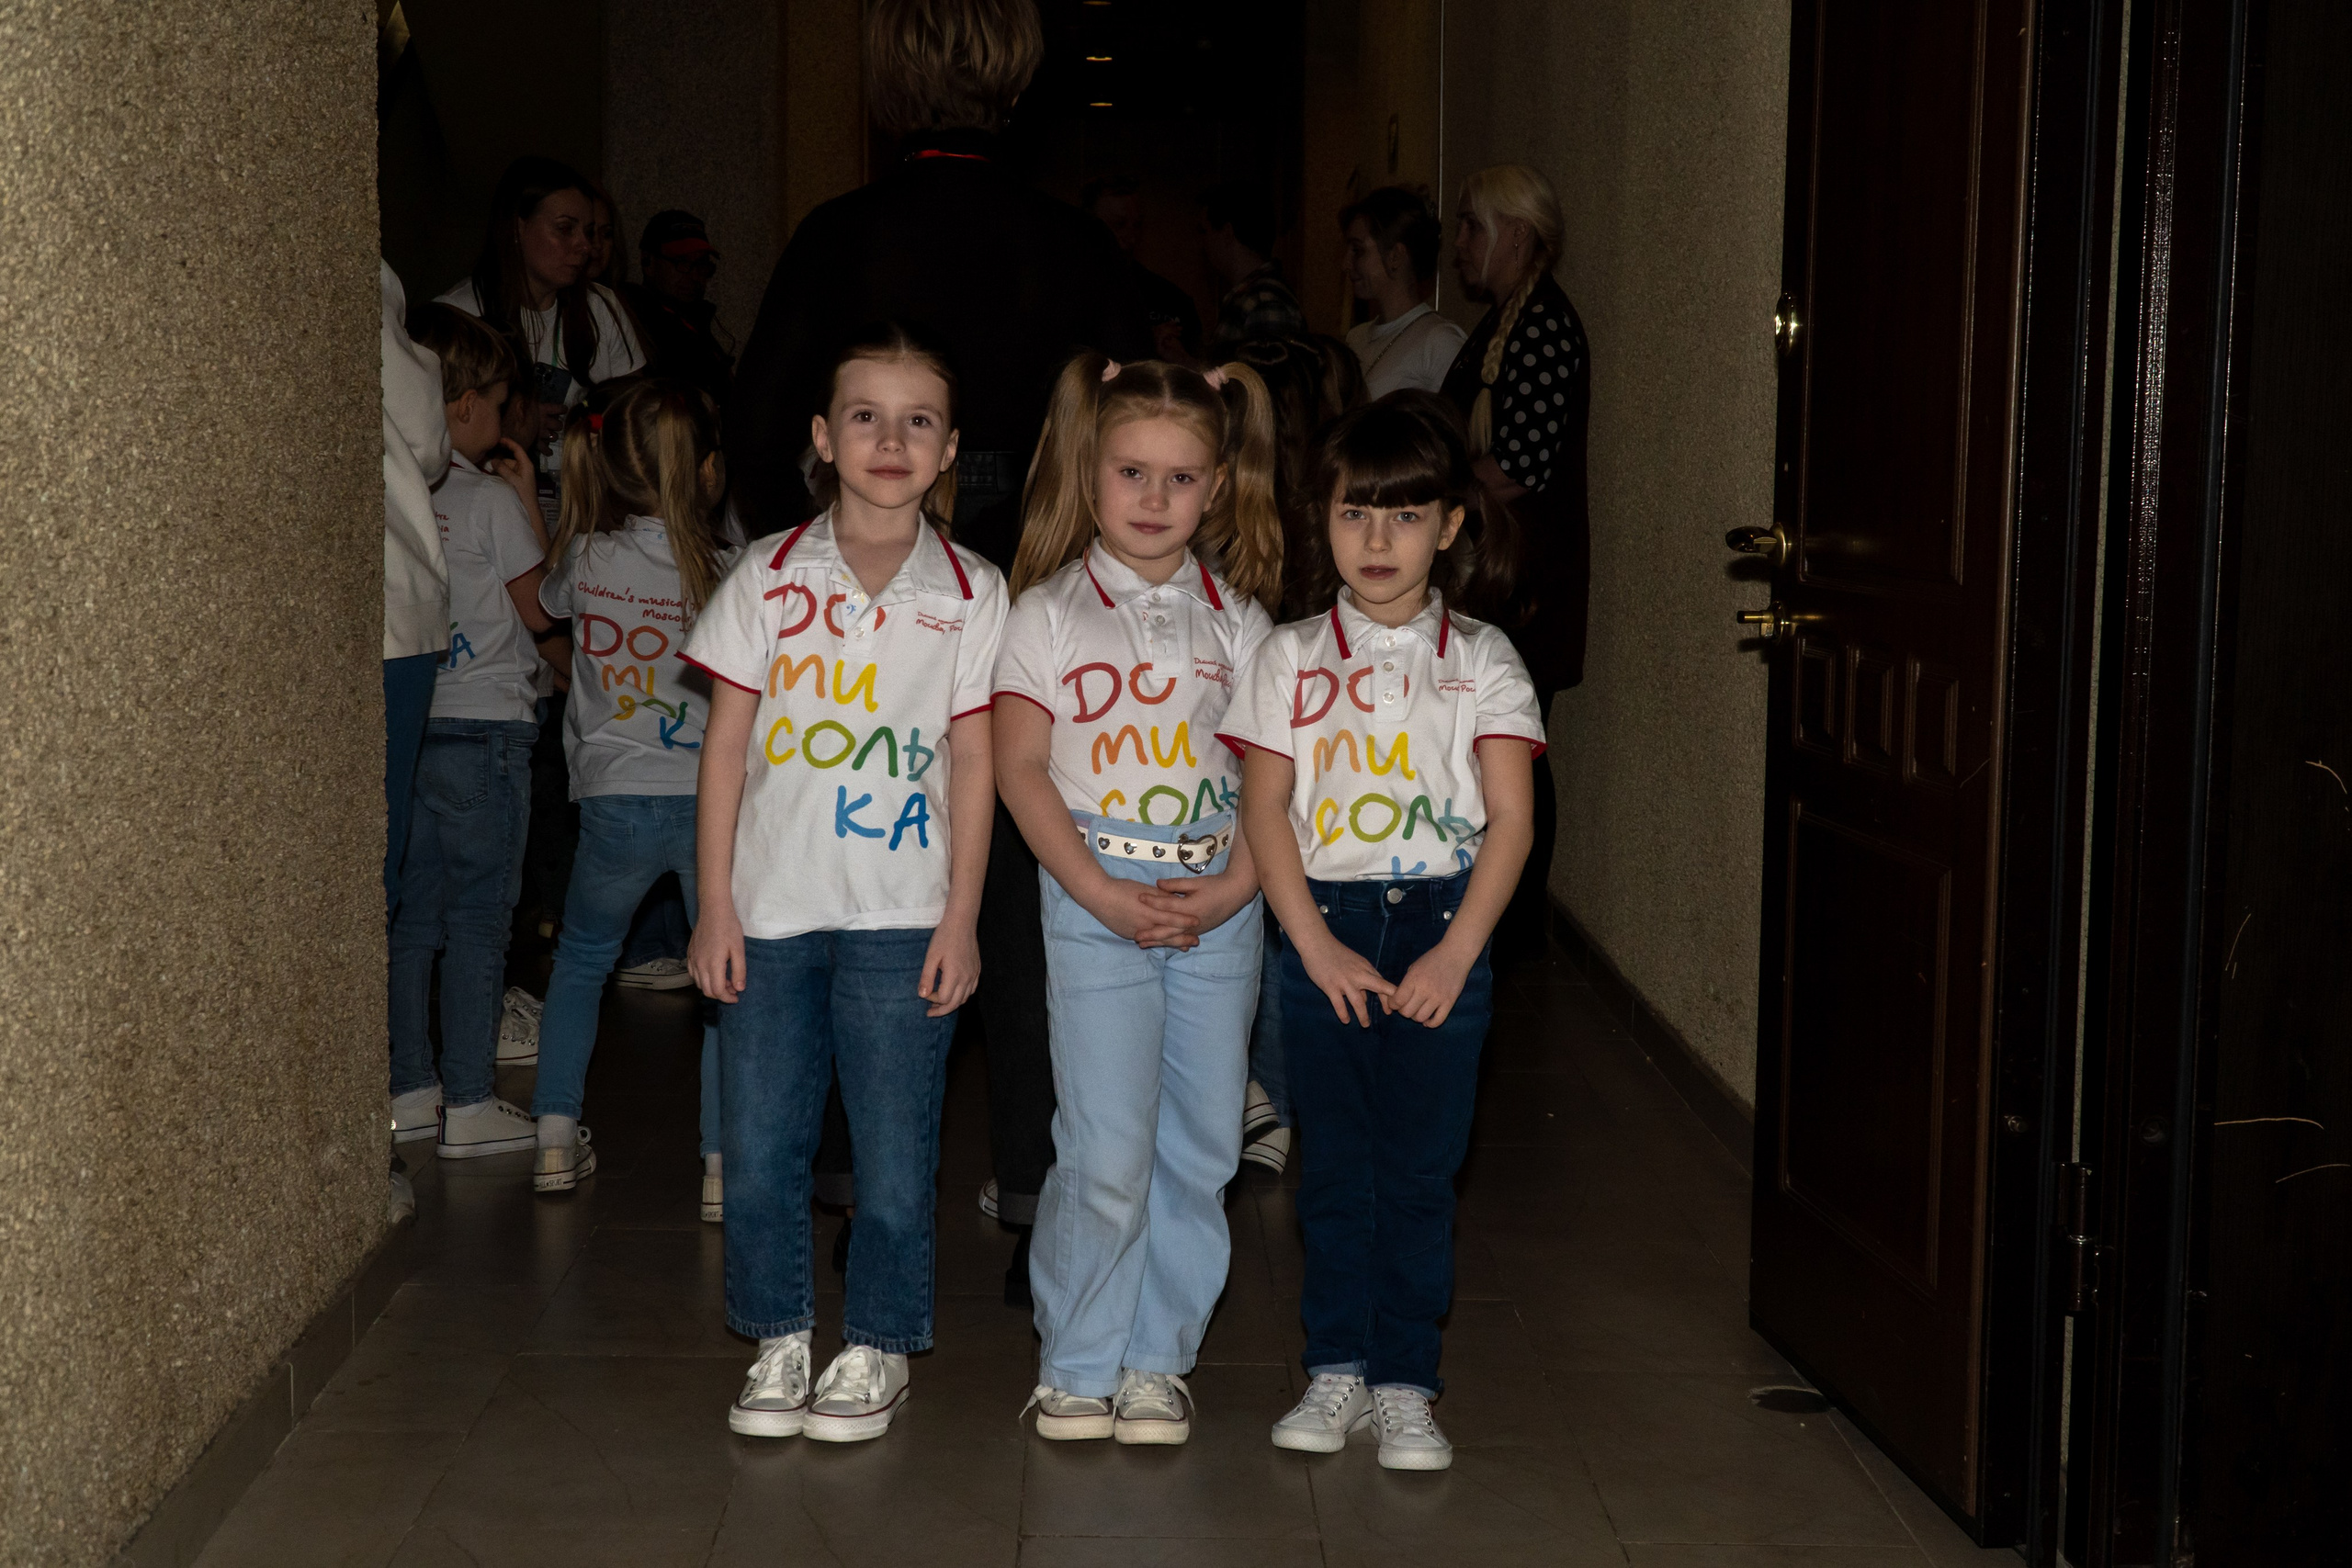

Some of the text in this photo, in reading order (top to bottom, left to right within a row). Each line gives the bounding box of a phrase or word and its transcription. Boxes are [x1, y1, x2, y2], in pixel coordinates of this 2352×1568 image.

[578, 581, 634, 604] Children's
[578, 613, 669, 661] DO
[602, 664, 655, 696] MI
